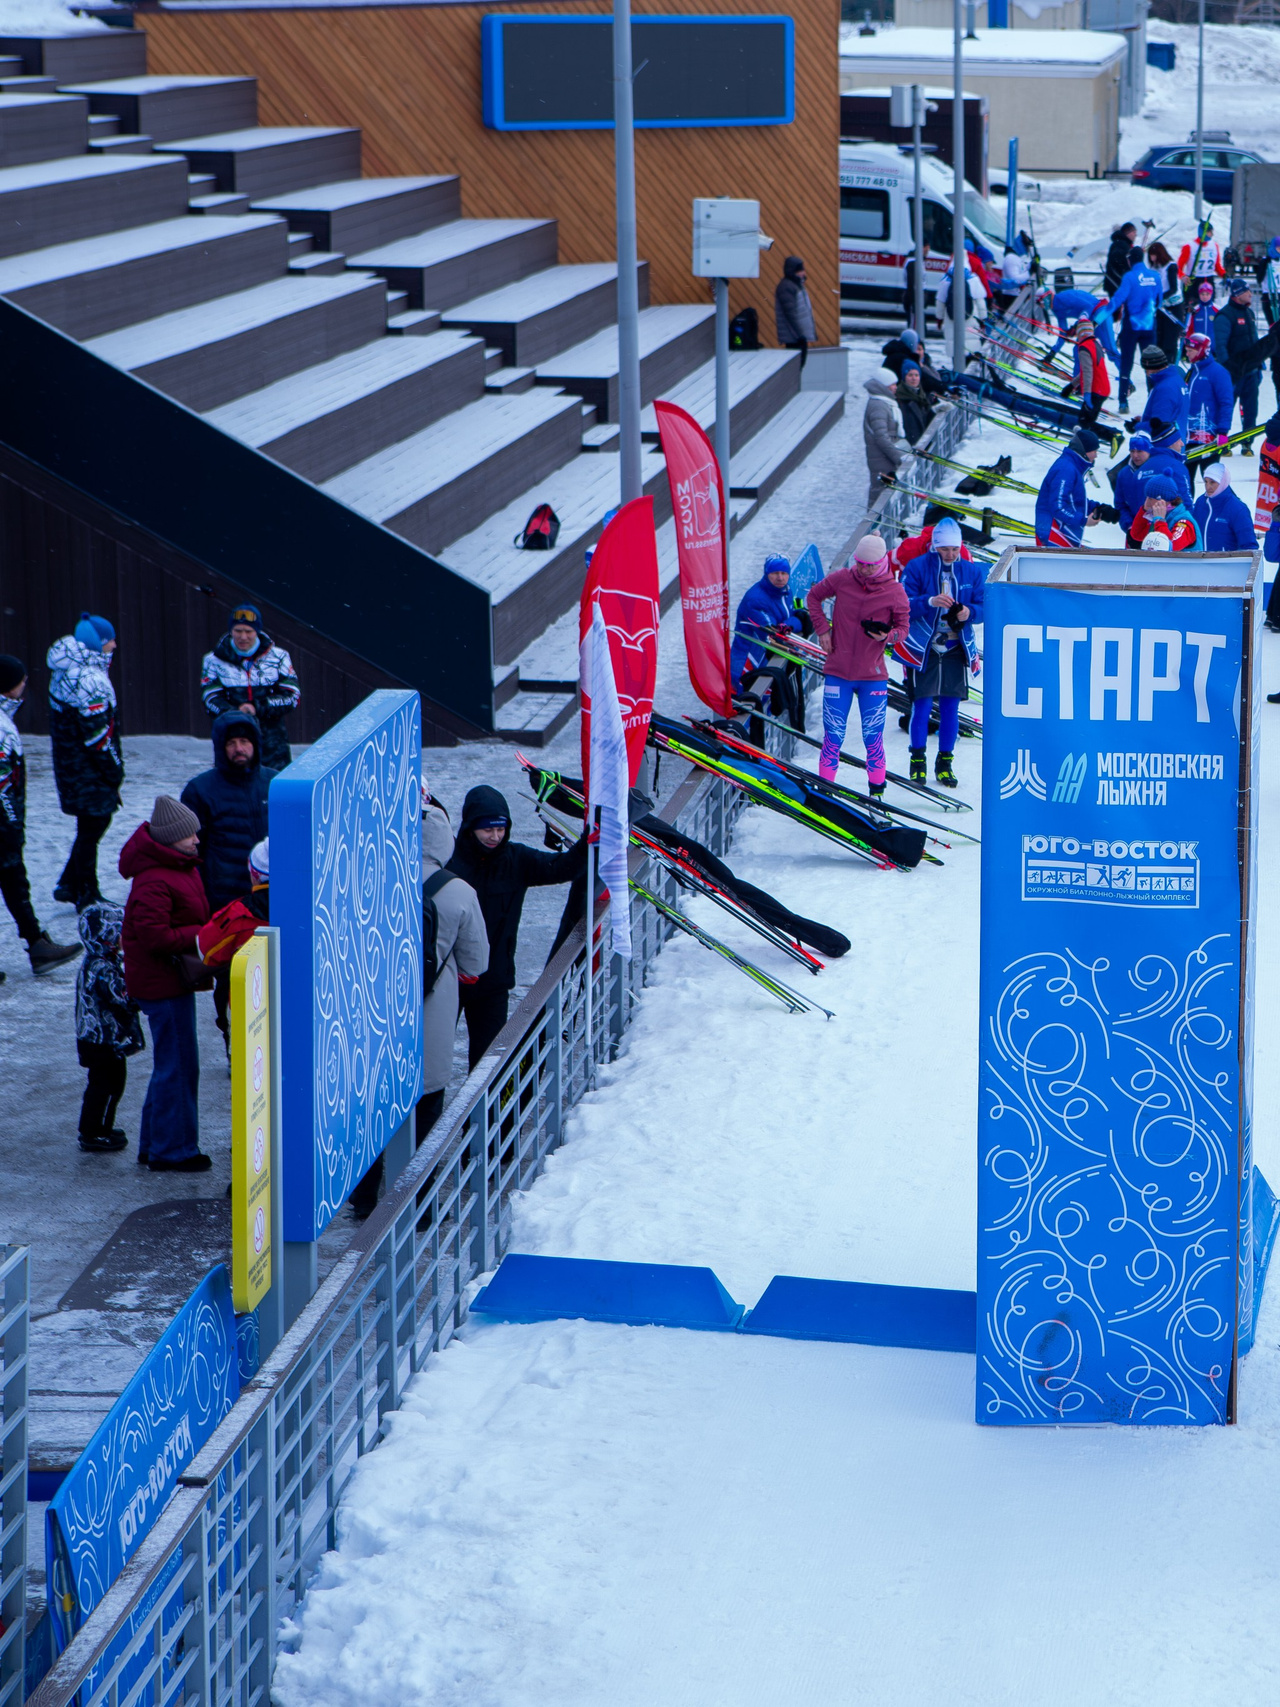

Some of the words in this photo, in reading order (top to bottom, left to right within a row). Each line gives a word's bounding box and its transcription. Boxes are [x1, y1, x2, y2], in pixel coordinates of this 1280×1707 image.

[856, 176, 871, 186] 777
[873, 177, 885, 187] 48
[886, 178, 898, 188] 03
[1197, 259, 1215, 271] 72
[1001, 625, 1227, 723] СТАРТ
[1097, 752, 1224, 780] МОСКОВСКАЯ
[1096, 780, 1167, 806] ЛЫЖНЯ
[1023, 836, 1199, 860] ЮГО-ВОСТОК
[1027, 885, 1069, 895] ОКРУЖНОЙ
[1069, 888, 1150, 902] БИАТЛОННО-ЛЫЖНЫЙ
[1151, 893, 1191, 902] КОМПЛЕКС
[118, 1414, 193, 1556] ЮГО-ВОСТОК
